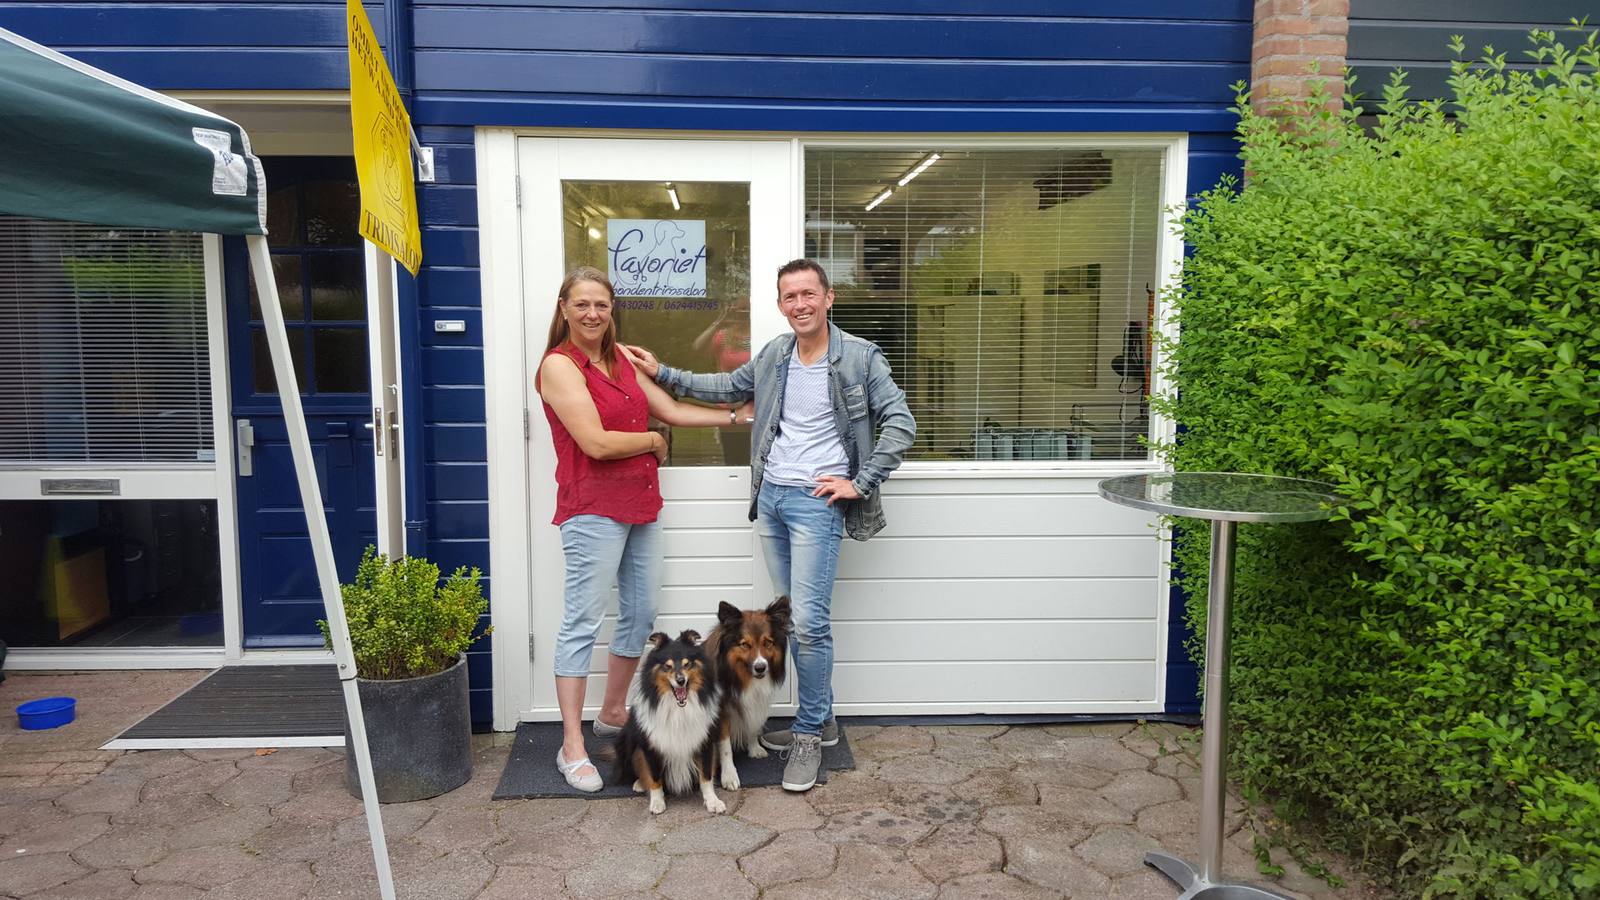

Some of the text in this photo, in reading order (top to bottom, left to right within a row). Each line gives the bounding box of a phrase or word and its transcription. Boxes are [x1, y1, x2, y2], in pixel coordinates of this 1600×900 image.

[352, 14, 378, 73] OMDAT
[352, 30, 368, 66] HET
[607, 228, 706, 274] favoriet
